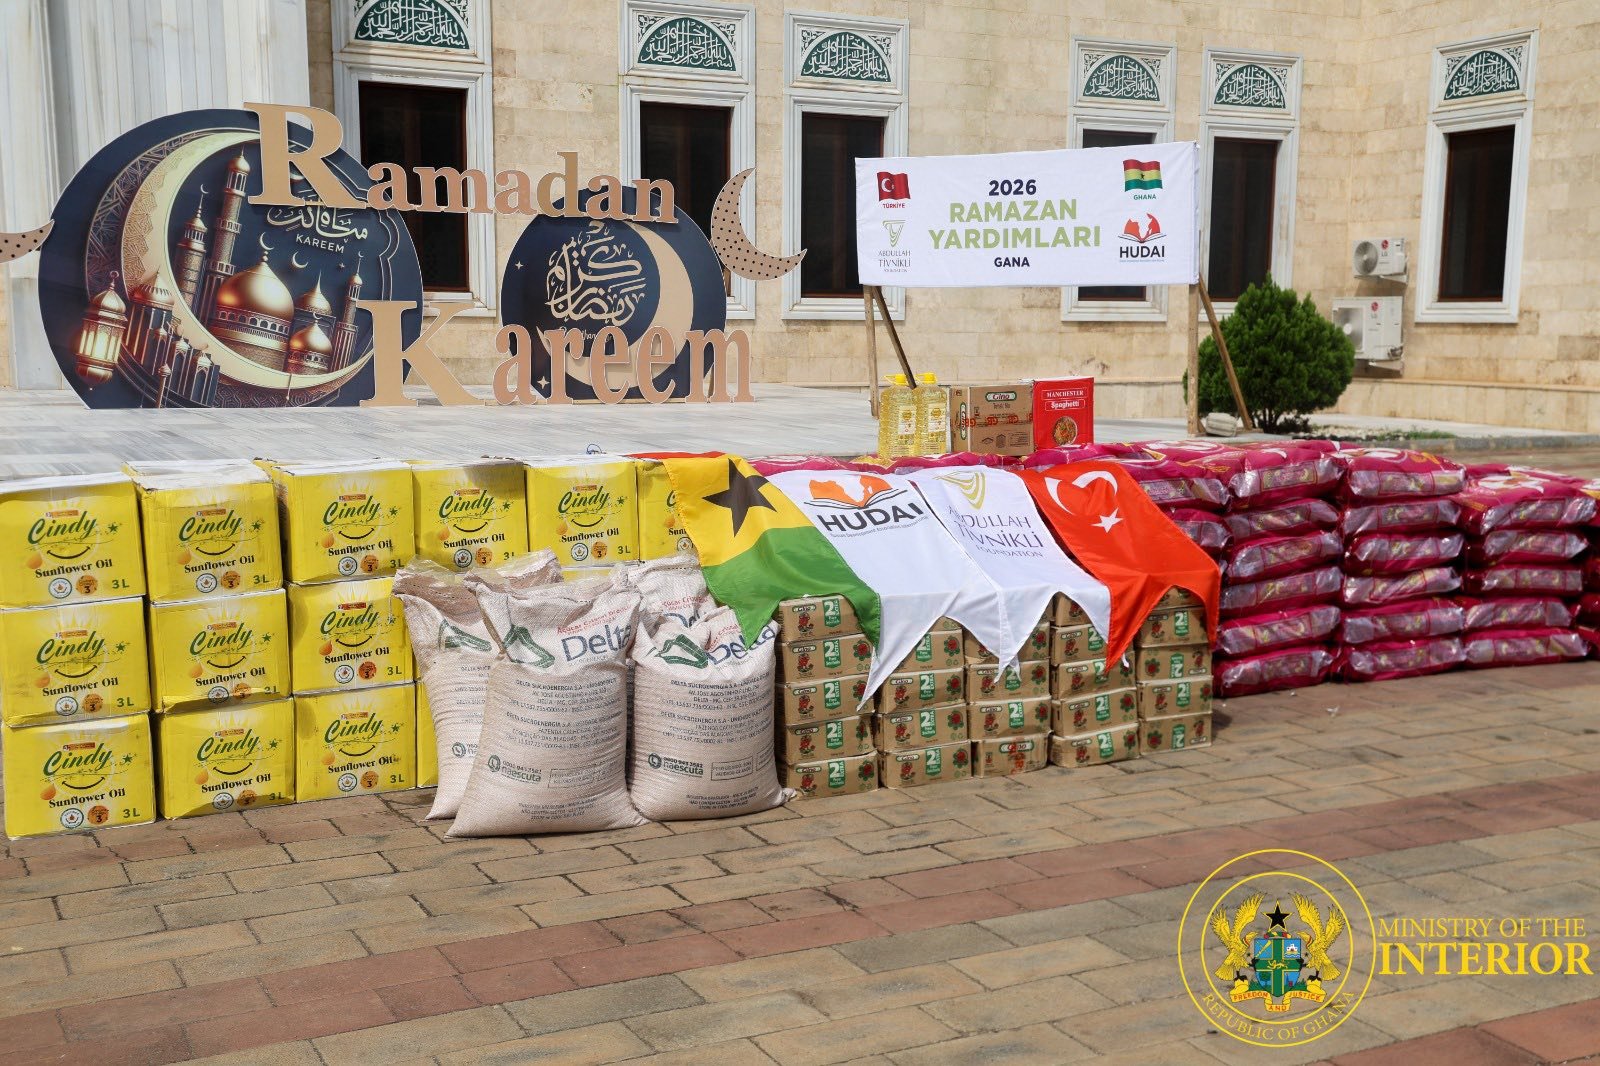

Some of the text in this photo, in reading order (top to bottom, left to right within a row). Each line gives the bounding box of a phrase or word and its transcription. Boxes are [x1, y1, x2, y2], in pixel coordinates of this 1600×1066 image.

[243, 102, 680, 224] Ramadan
[988, 179, 1037, 196] 2026
[950, 199, 1077, 223] RAMAZAN
[296, 234, 344, 253] KAREEM
[928, 226, 1100, 249] YARDIMLARI
[1120, 246, 1164, 258] HUDAI
[994, 257, 1030, 268] GANA
[356, 300, 756, 408] Kareem
[1051, 400, 1079, 409] Spaghetti
[439, 490, 493, 518] Cindy
[558, 486, 609, 513] Cindy
[323, 496, 380, 525] Cindy
[817, 502, 924, 532] HUDAI
[28, 511, 96, 544] Cindy
[179, 510, 242, 541] Cindy
[444, 533, 505, 548] Sunflower Oil
[561, 528, 619, 543] Sunflower Oil
[328, 540, 393, 556] Sunflower Oil
[35, 559, 112, 578] Sunflower Oil
[185, 555, 255, 573] Sunflower Oil
[824, 601, 836, 616] 2
[320, 605, 379, 635] Cindy
[1175, 612, 1184, 626] 2
[36, 631, 105, 664] Cindy
[190, 623, 252, 655] Cindy
[561, 624, 632, 662] Delta
[324, 647, 390, 664] Sunflower Oil
[824, 642, 836, 657] 2
[195, 667, 266, 686] Sunflower Oil
[921, 675, 930, 690] 2
[42, 677, 118, 696] Sunflower Oil
[824, 682, 836, 699] 2
[1178, 684, 1186, 697] 2
[1010, 703, 1019, 718] 2
[1096, 697, 1105, 711] 2
[324, 713, 382, 743] Cindy
[921, 712, 930, 727] 2
[827, 723, 838, 738] 2
[197, 729, 259, 761] Cindy
[1098, 735, 1107, 749] 2
[43, 743, 112, 776] Cindy
[328, 756, 393, 773] Sunflower Oil
[927, 750, 935, 765] 2
[501, 765, 541, 782] naescuta
[663, 761, 704, 776] naescuta
[830, 762, 840, 778] 2
[201, 773, 271, 793] Sunflower Oil
[49, 788, 126, 808] Sunflower Oil
